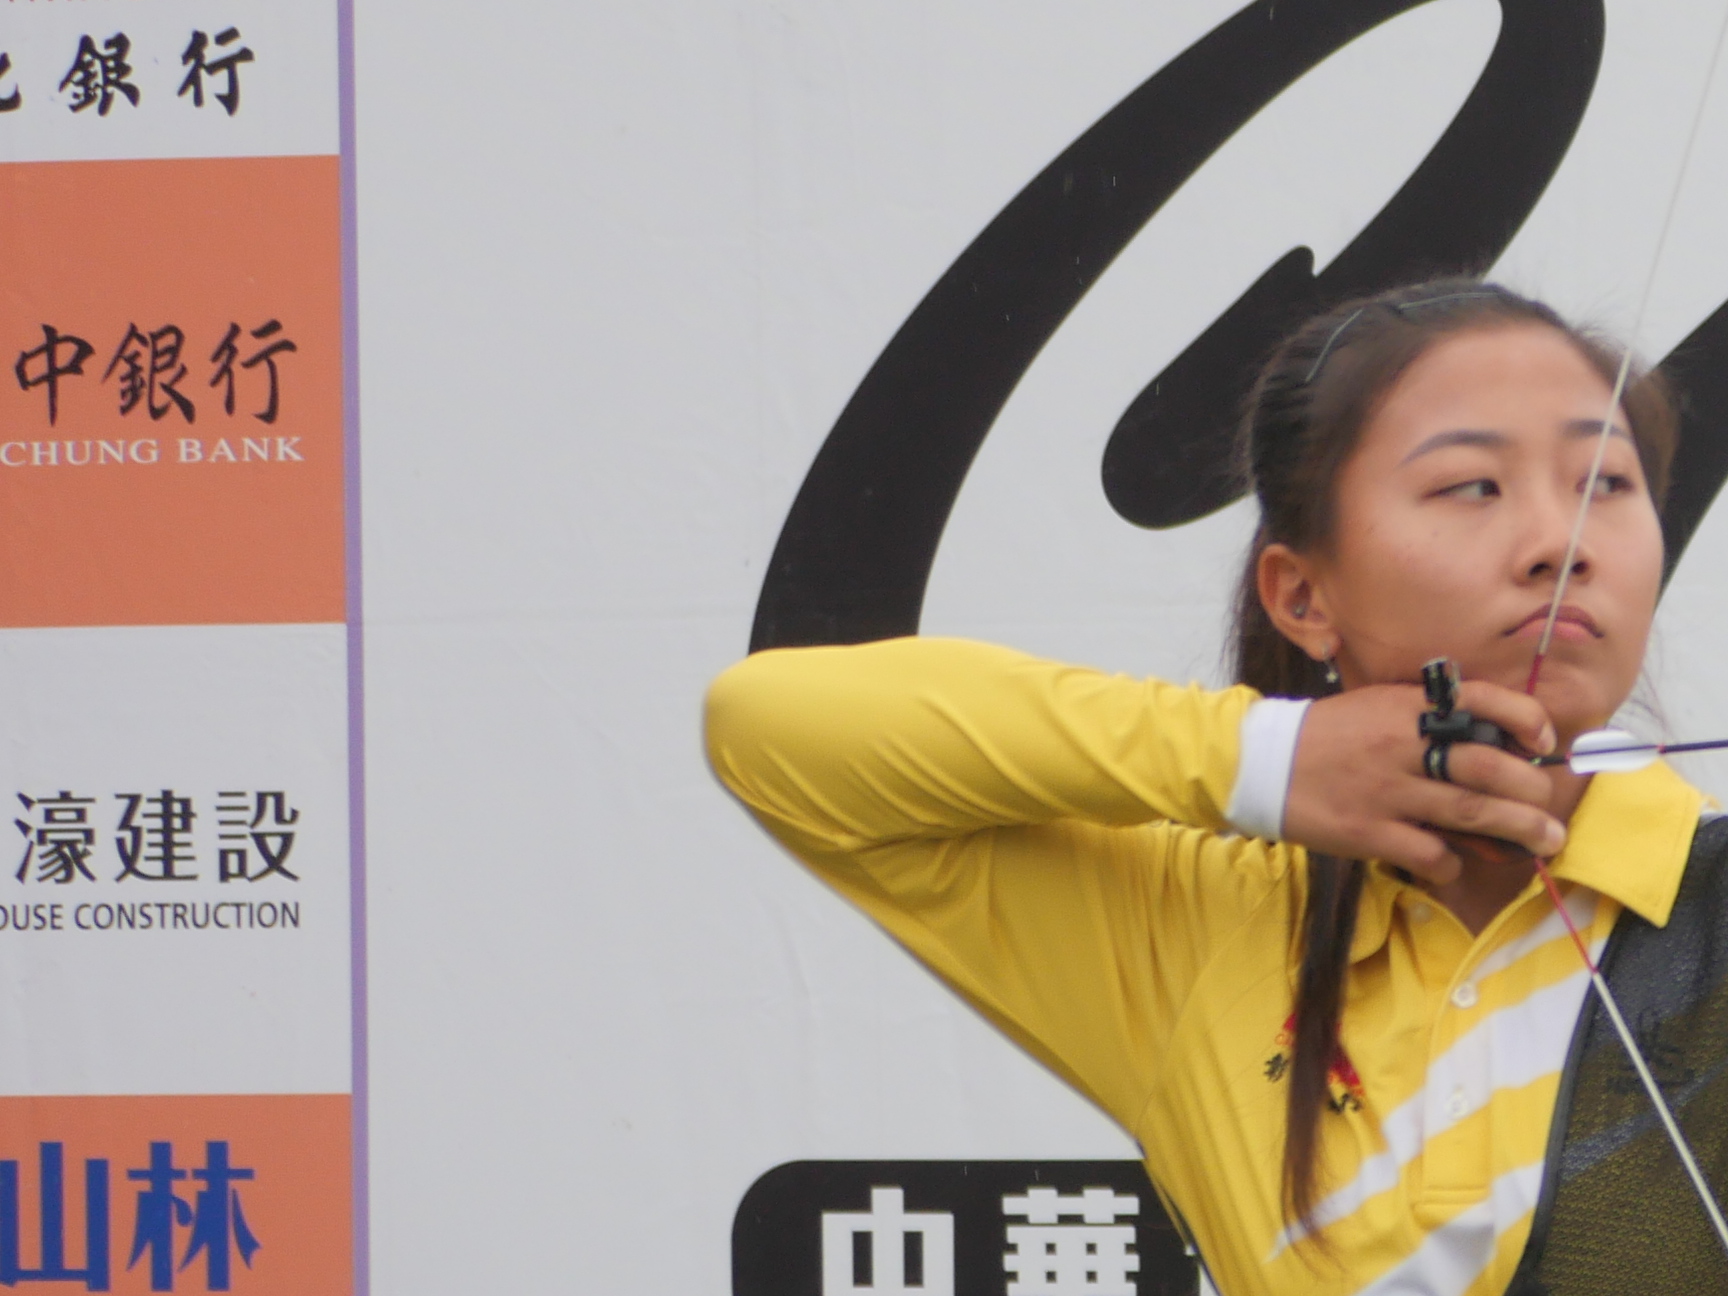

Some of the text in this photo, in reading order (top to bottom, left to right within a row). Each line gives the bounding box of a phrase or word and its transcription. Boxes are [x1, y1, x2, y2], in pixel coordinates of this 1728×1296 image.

[0, 27, 255, 117] 銀行
[4, 319, 297, 427] 中銀行
[0, 437, 305, 466] CHUNG BANK
[4, 790, 300, 884] 濠建設
[74, 902, 299, 930] CONSTRUCTION
[0, 1141, 263, 1292] 山林
